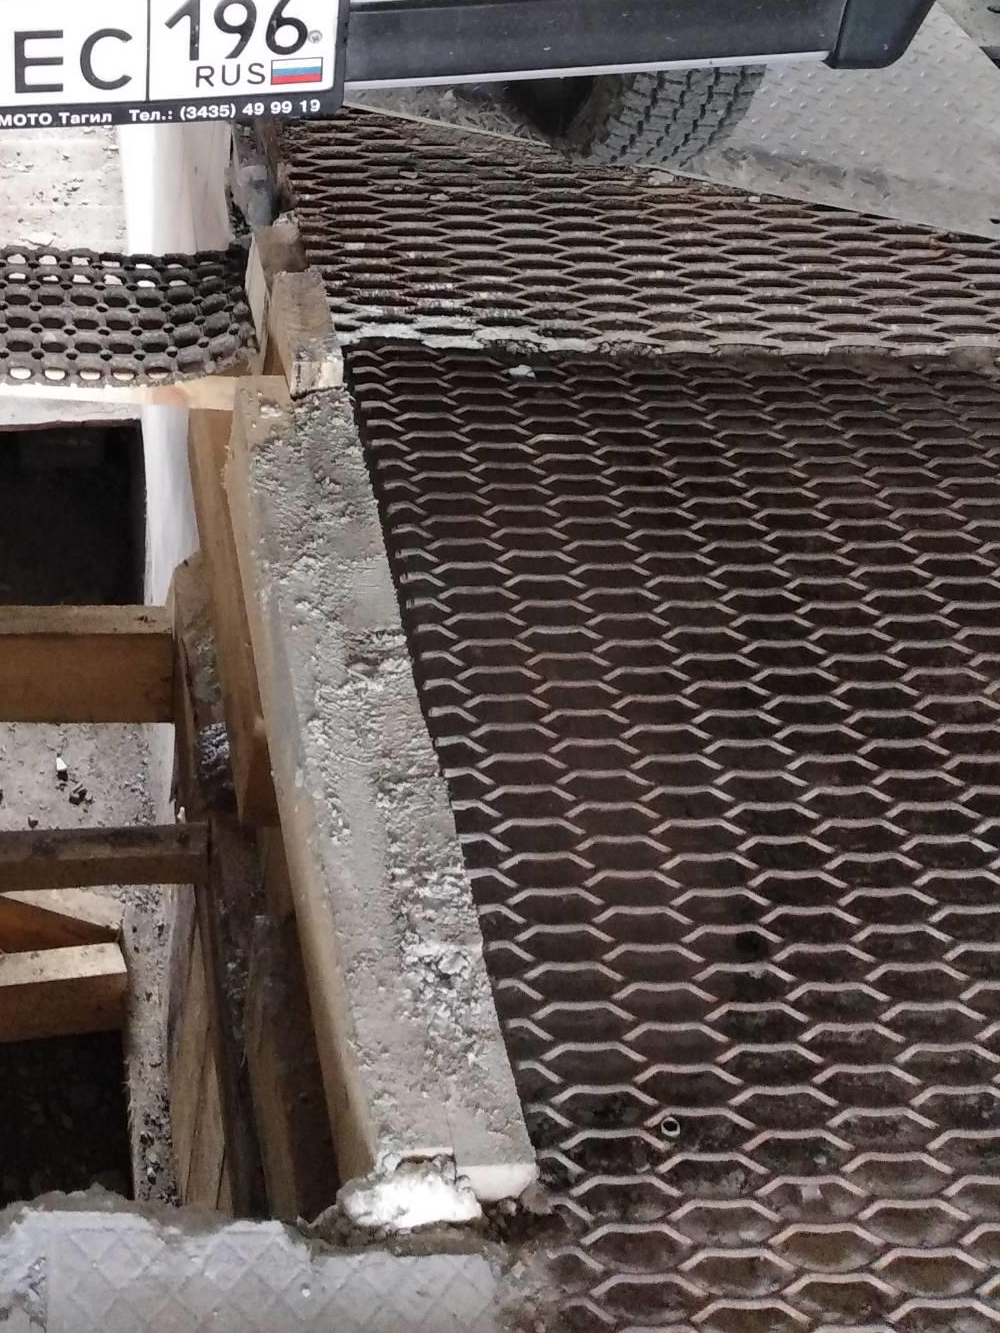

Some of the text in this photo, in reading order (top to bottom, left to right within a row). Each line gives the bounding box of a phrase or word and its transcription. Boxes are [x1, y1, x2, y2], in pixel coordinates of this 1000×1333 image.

[195, 62, 266, 88] RUS
[59, 111, 112, 125] Тагил
[129, 98, 321, 122] Тел.: (3435) 49 99 19
